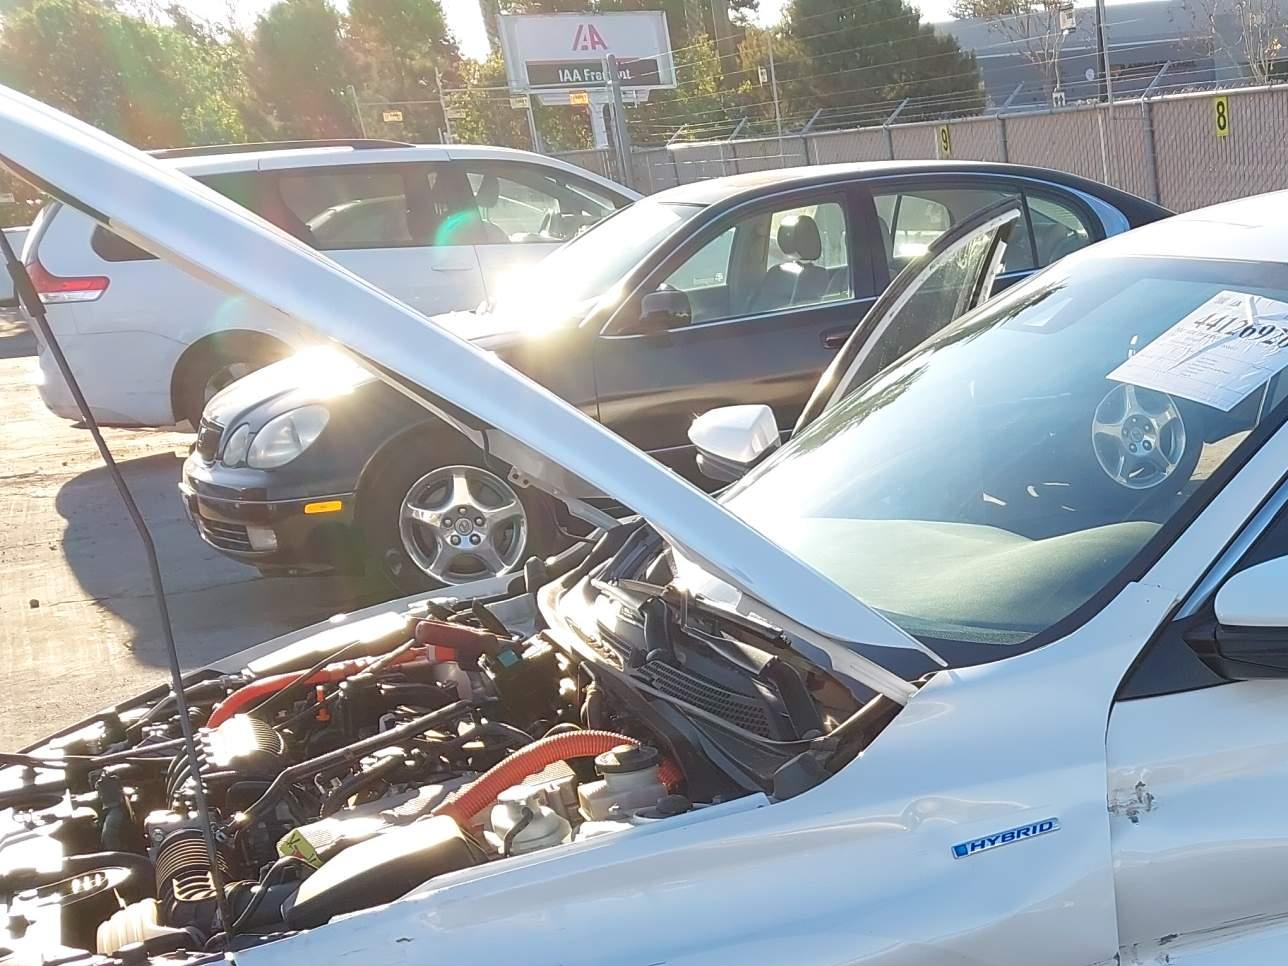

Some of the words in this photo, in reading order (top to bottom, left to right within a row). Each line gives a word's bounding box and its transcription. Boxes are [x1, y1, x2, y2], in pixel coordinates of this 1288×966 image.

[558, 69, 582, 83] IAA
[1216, 101, 1227, 131] 8
[941, 128, 949, 151] 9
[969, 821, 1054, 852] HYBRID
